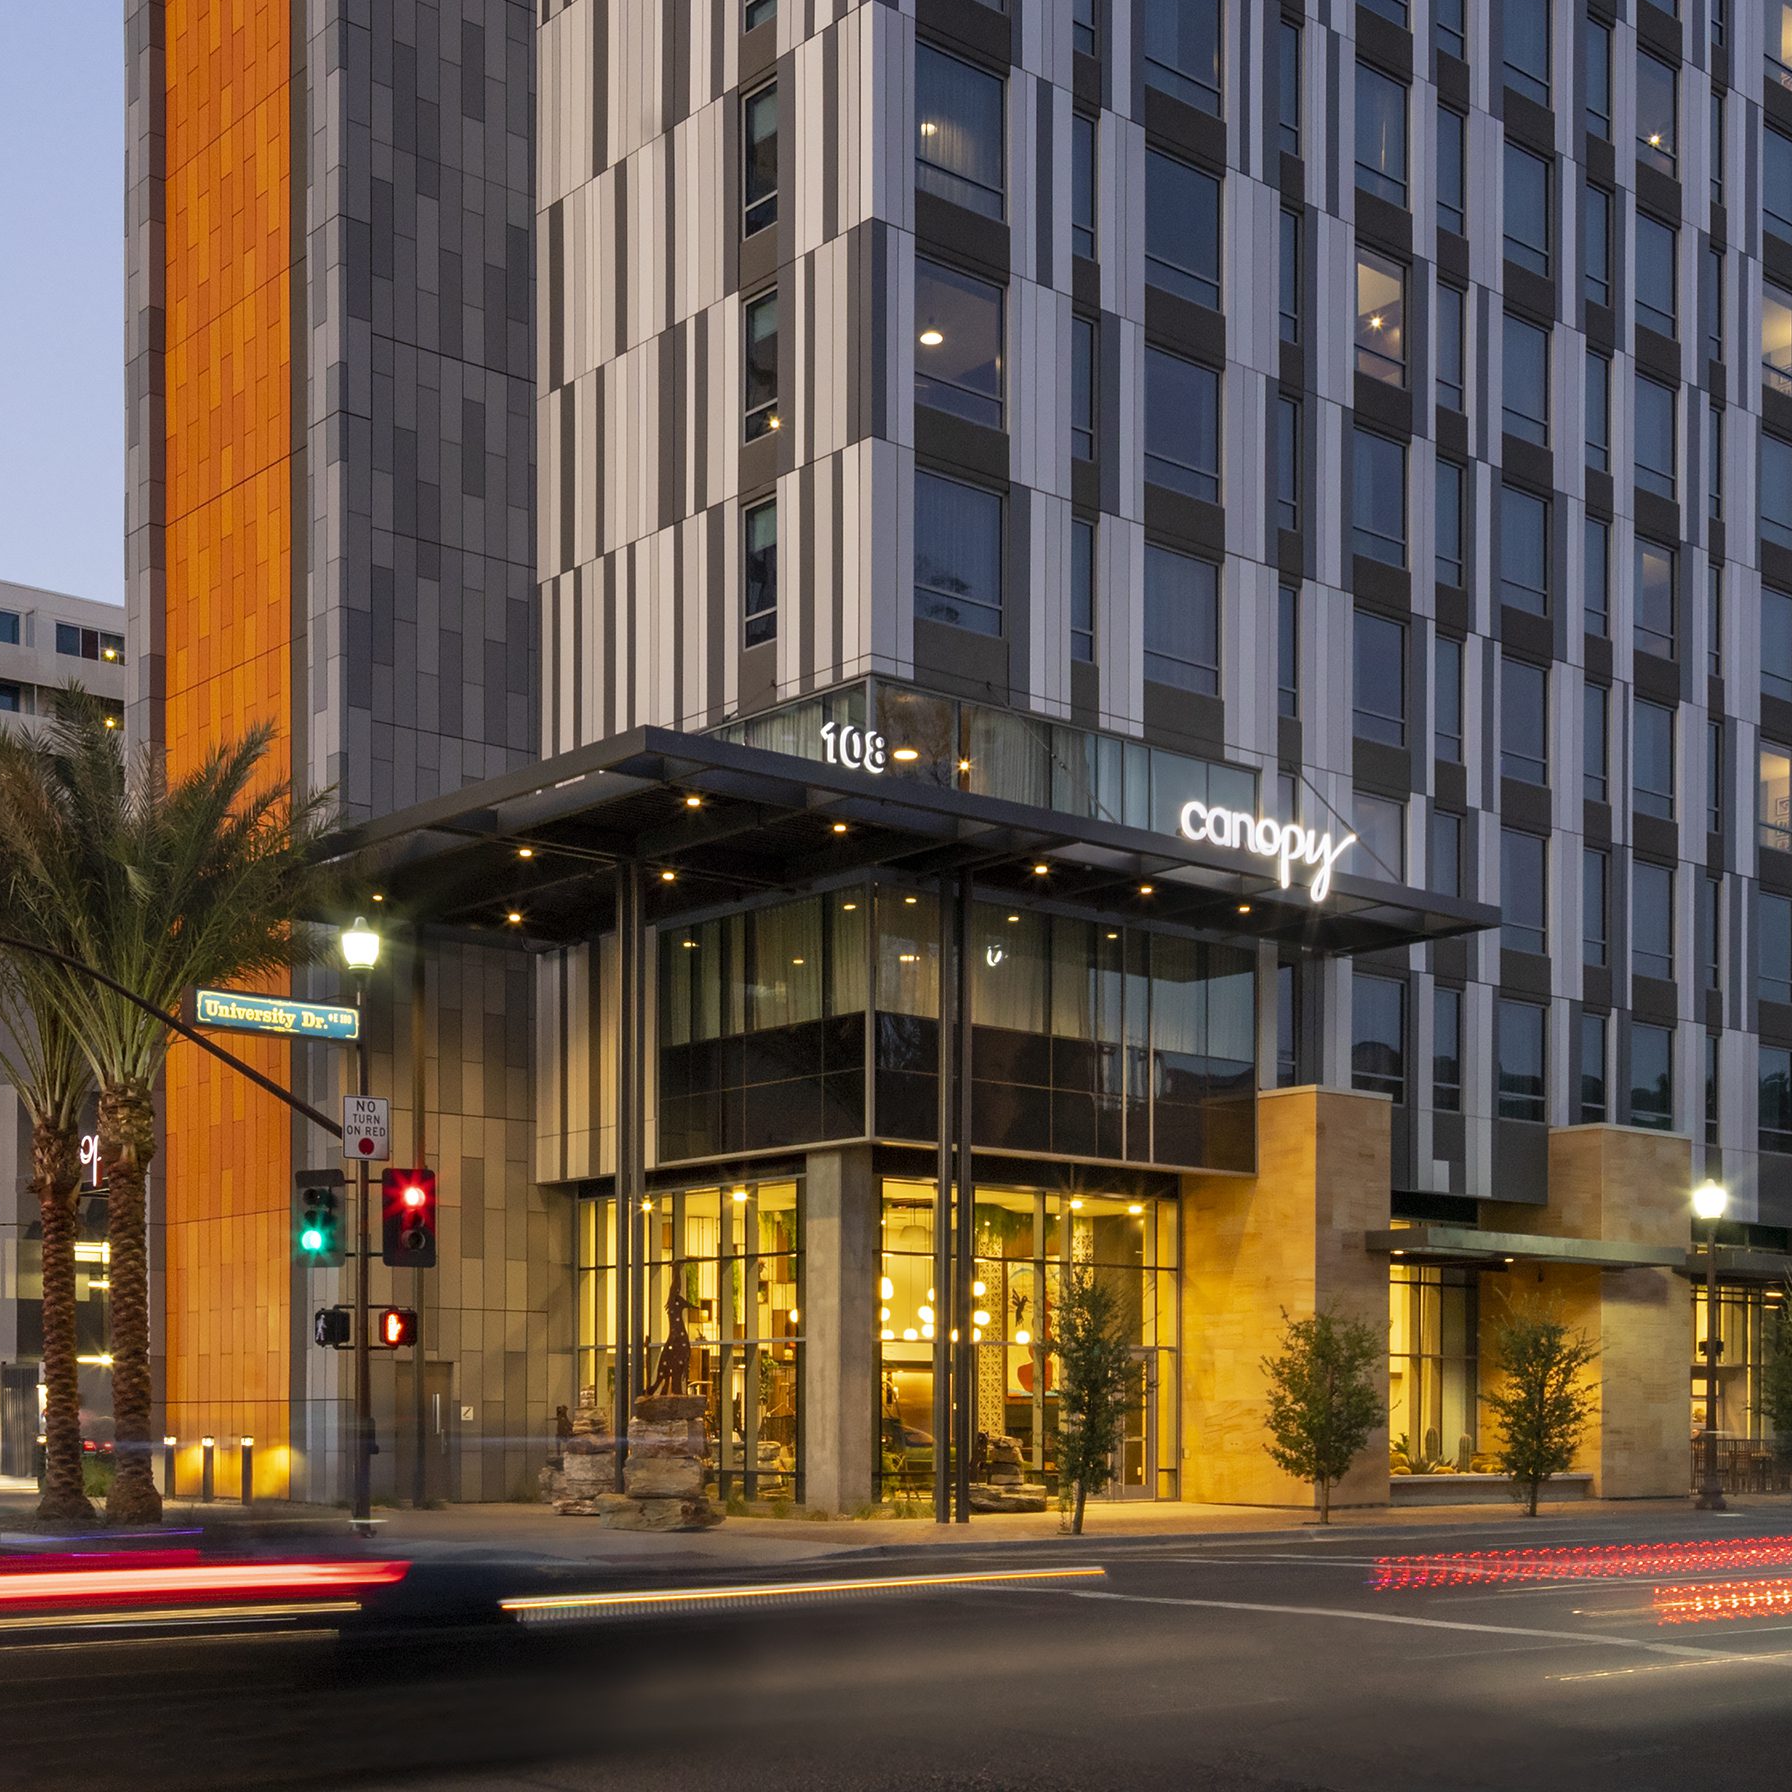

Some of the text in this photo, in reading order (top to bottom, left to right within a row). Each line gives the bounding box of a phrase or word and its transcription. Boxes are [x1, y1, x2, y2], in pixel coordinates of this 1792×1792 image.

[820, 721, 887, 774] 108
[1180, 800, 1357, 902] canopy
[204, 999, 328, 1029] University Dr.
[356, 1100, 376, 1113] NO
[353, 1113, 380, 1125] TURN
[346, 1125, 386, 1137] ON RED
